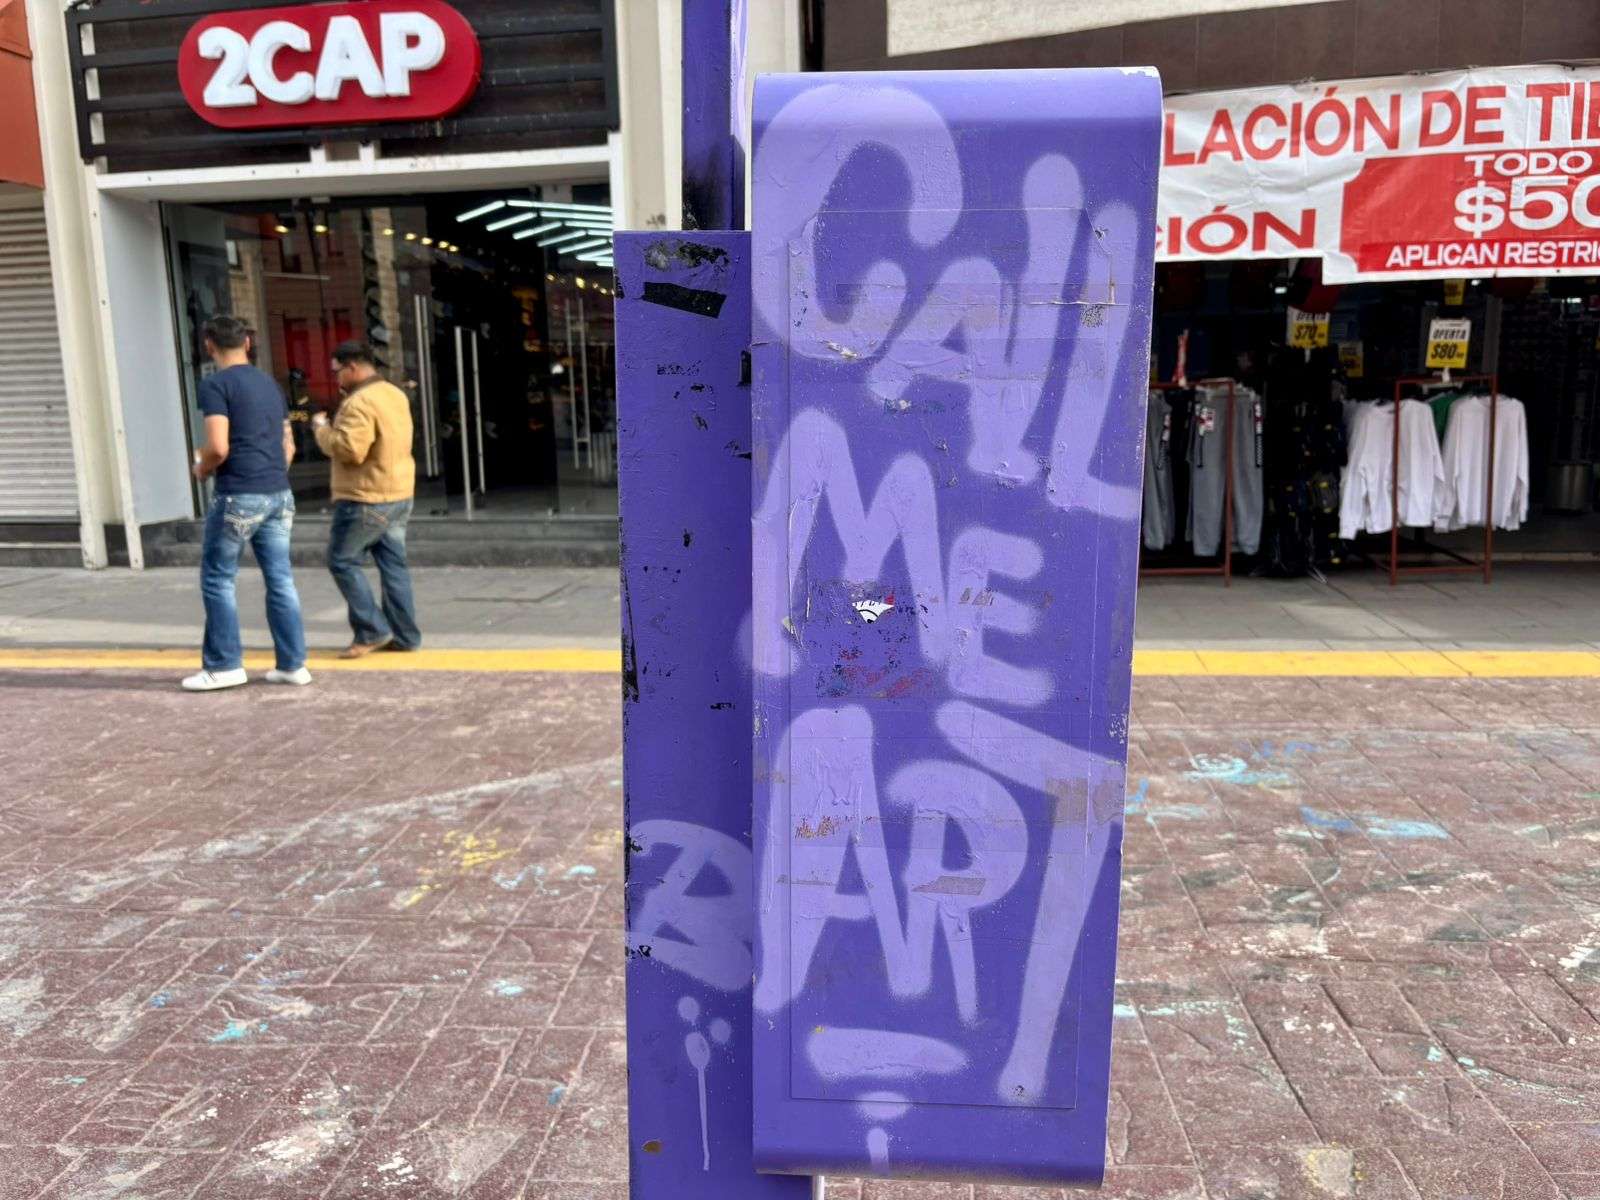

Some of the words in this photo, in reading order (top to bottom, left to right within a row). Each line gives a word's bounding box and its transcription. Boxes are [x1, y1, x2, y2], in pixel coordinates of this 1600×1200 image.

[199, 11, 445, 107] 2CAP
[1419, 85, 1507, 148] DE
[1464, 151, 1592, 178] TODO
[1156, 204, 1316, 255] IÓN
[1386, 243, 1499, 267] APLICAN
[1504, 241, 1600, 264] RESTRI
[1431, 342, 1458, 360] $80
[1433, 328, 1467, 340] OFERTA
[738, 407, 1056, 707] ME
